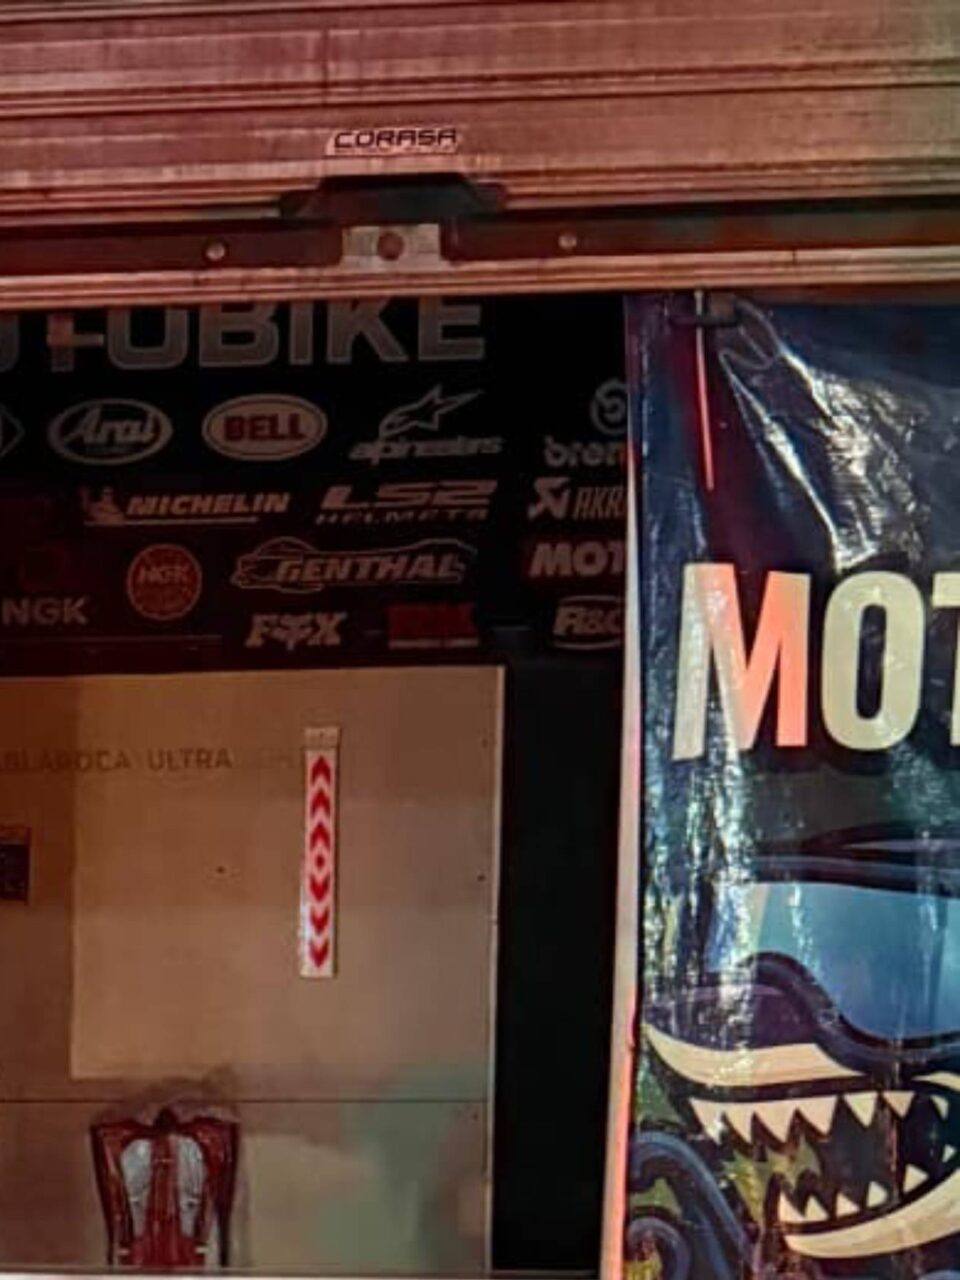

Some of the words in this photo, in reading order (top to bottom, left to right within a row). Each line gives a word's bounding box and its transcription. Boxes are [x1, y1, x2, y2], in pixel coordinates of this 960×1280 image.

[334, 127, 457, 148] CORASA
[223, 413, 306, 442] BELL
[126, 490, 291, 515] MICHELIN
[319, 478, 499, 510] LS2
[1, 596, 90, 625] NGK
[147, 746, 234, 772] ULTRA
